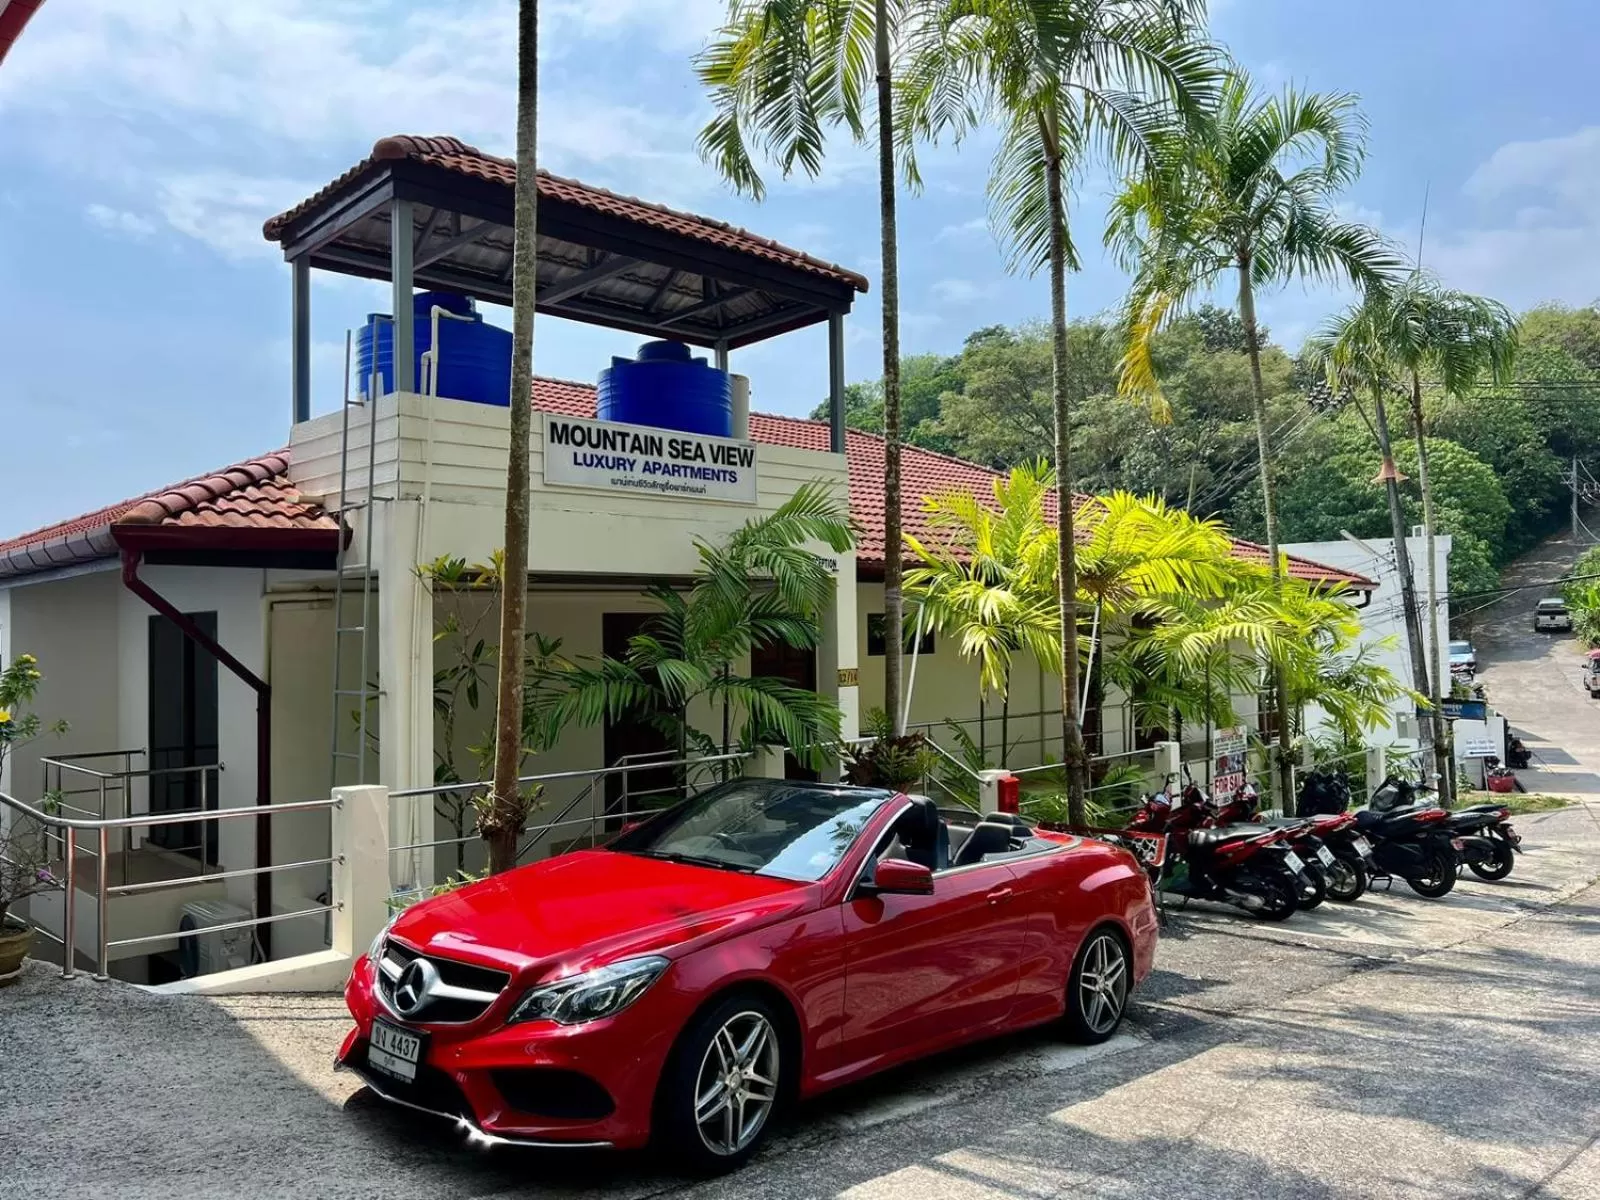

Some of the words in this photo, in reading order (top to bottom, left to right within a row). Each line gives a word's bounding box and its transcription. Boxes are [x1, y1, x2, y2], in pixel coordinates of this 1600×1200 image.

[550, 422, 663, 457] MOUNTAIN
[668, 437, 706, 463] SEA
[709, 444, 754, 468] VIEW
[573, 452, 637, 472] LUXURY
[642, 461, 738, 483] APARTMENTS
[1215, 777, 1228, 795] FOR
[390, 1033, 418, 1059] 4437
